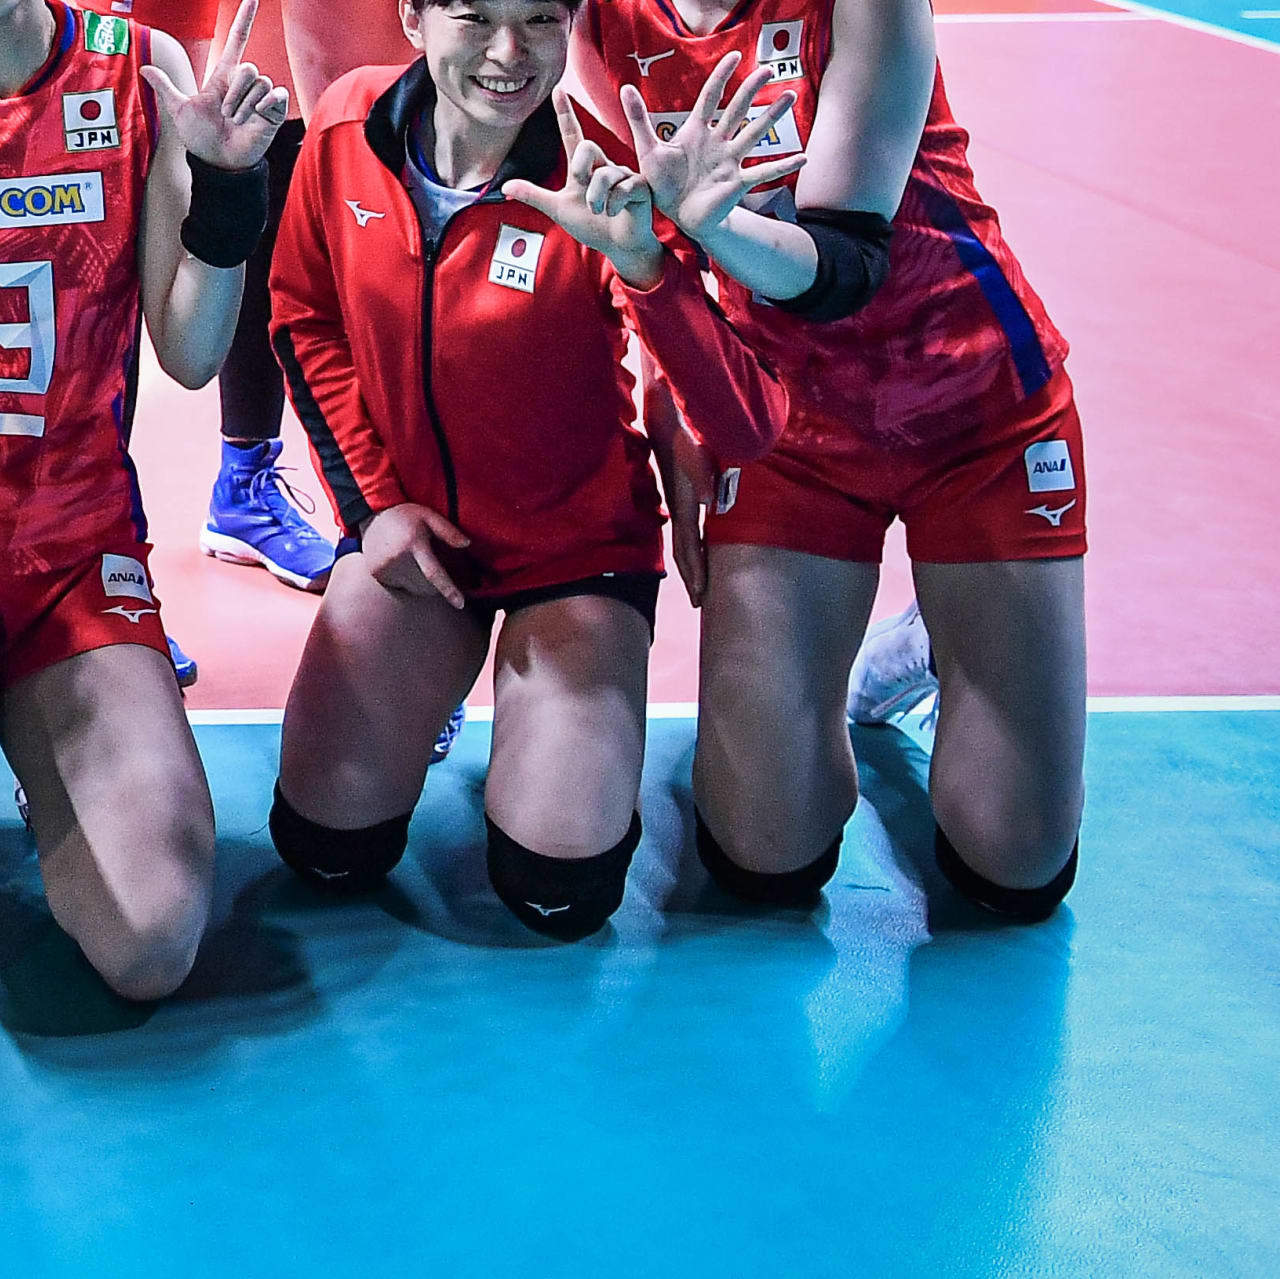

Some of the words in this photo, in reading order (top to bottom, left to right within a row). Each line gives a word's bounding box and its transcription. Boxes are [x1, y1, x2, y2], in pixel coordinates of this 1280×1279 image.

[74, 130, 113, 147] JPN
[496, 265, 528, 287] JPN
[1032, 461, 1060, 474] ANA
[108, 572, 136, 584] ANA
